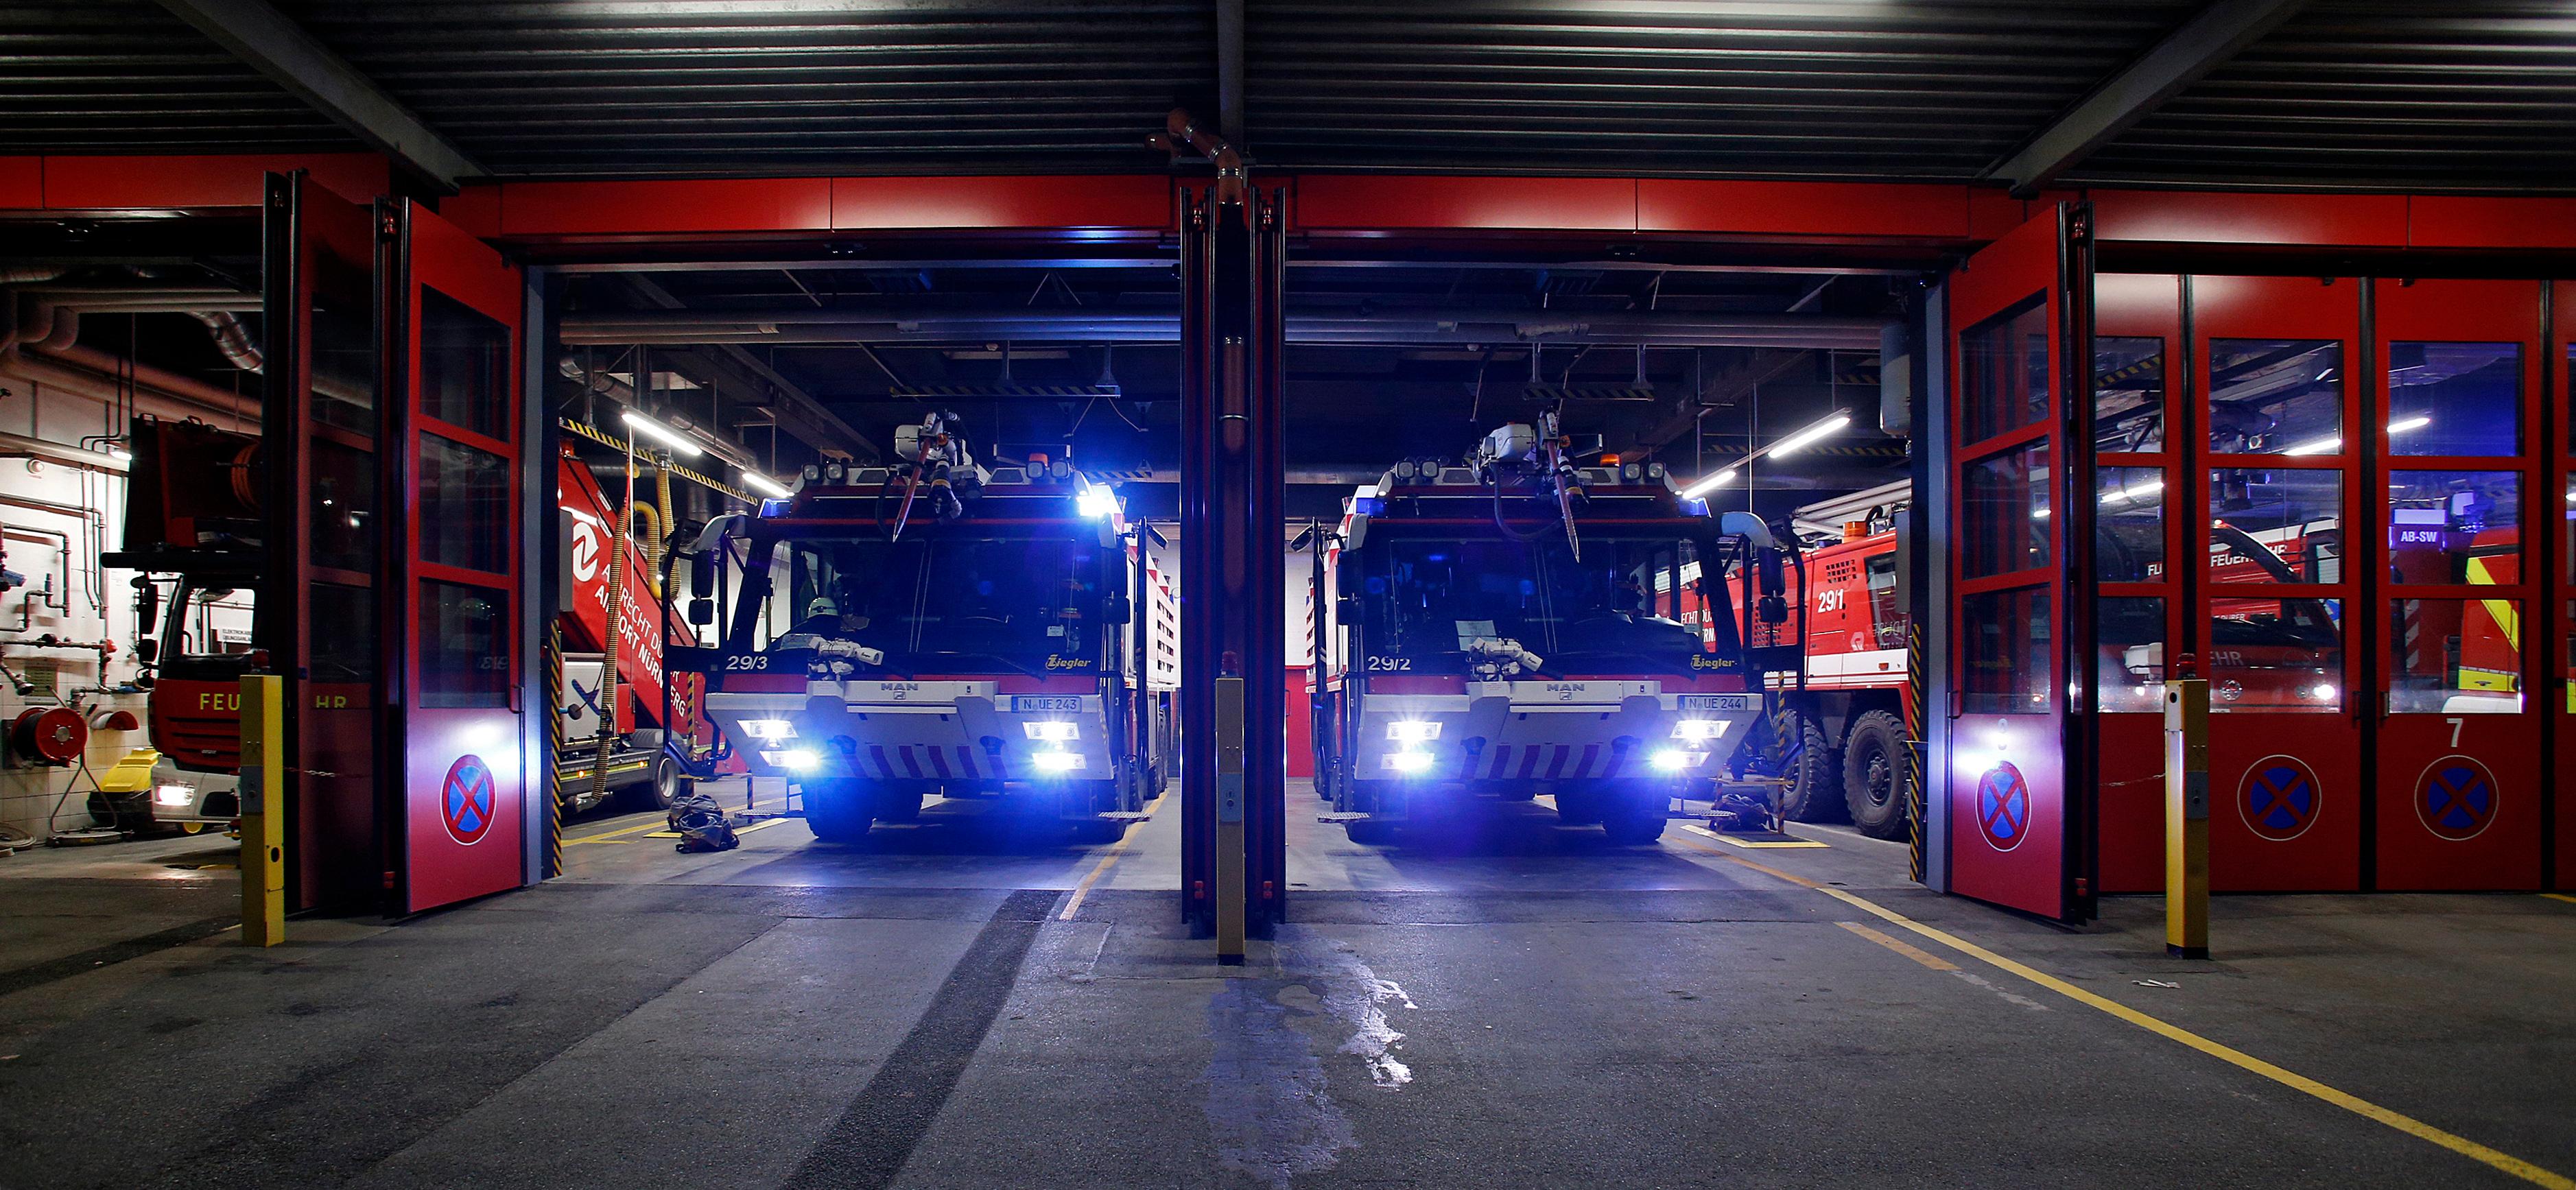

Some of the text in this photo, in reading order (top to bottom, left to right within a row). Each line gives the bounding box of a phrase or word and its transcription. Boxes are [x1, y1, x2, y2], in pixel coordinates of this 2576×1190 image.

[2401, 531, 2437, 543] AB-SW
[602, 563, 652, 638] ARECHT
[1818, 588, 1844, 613] 29/1
[726, 655, 768, 670] 29/3
[1045, 654, 1091, 670] Ziegler
[1367, 656, 1411, 671] 29/2
[1690, 654, 1735, 670] Ziegler
[638, 643, 686, 717] NÜRNERG
[1024, 699, 1076, 710] N UE 243
[1689, 698, 1742, 709] N UE 244
[2446, 717, 2463, 748] 7
